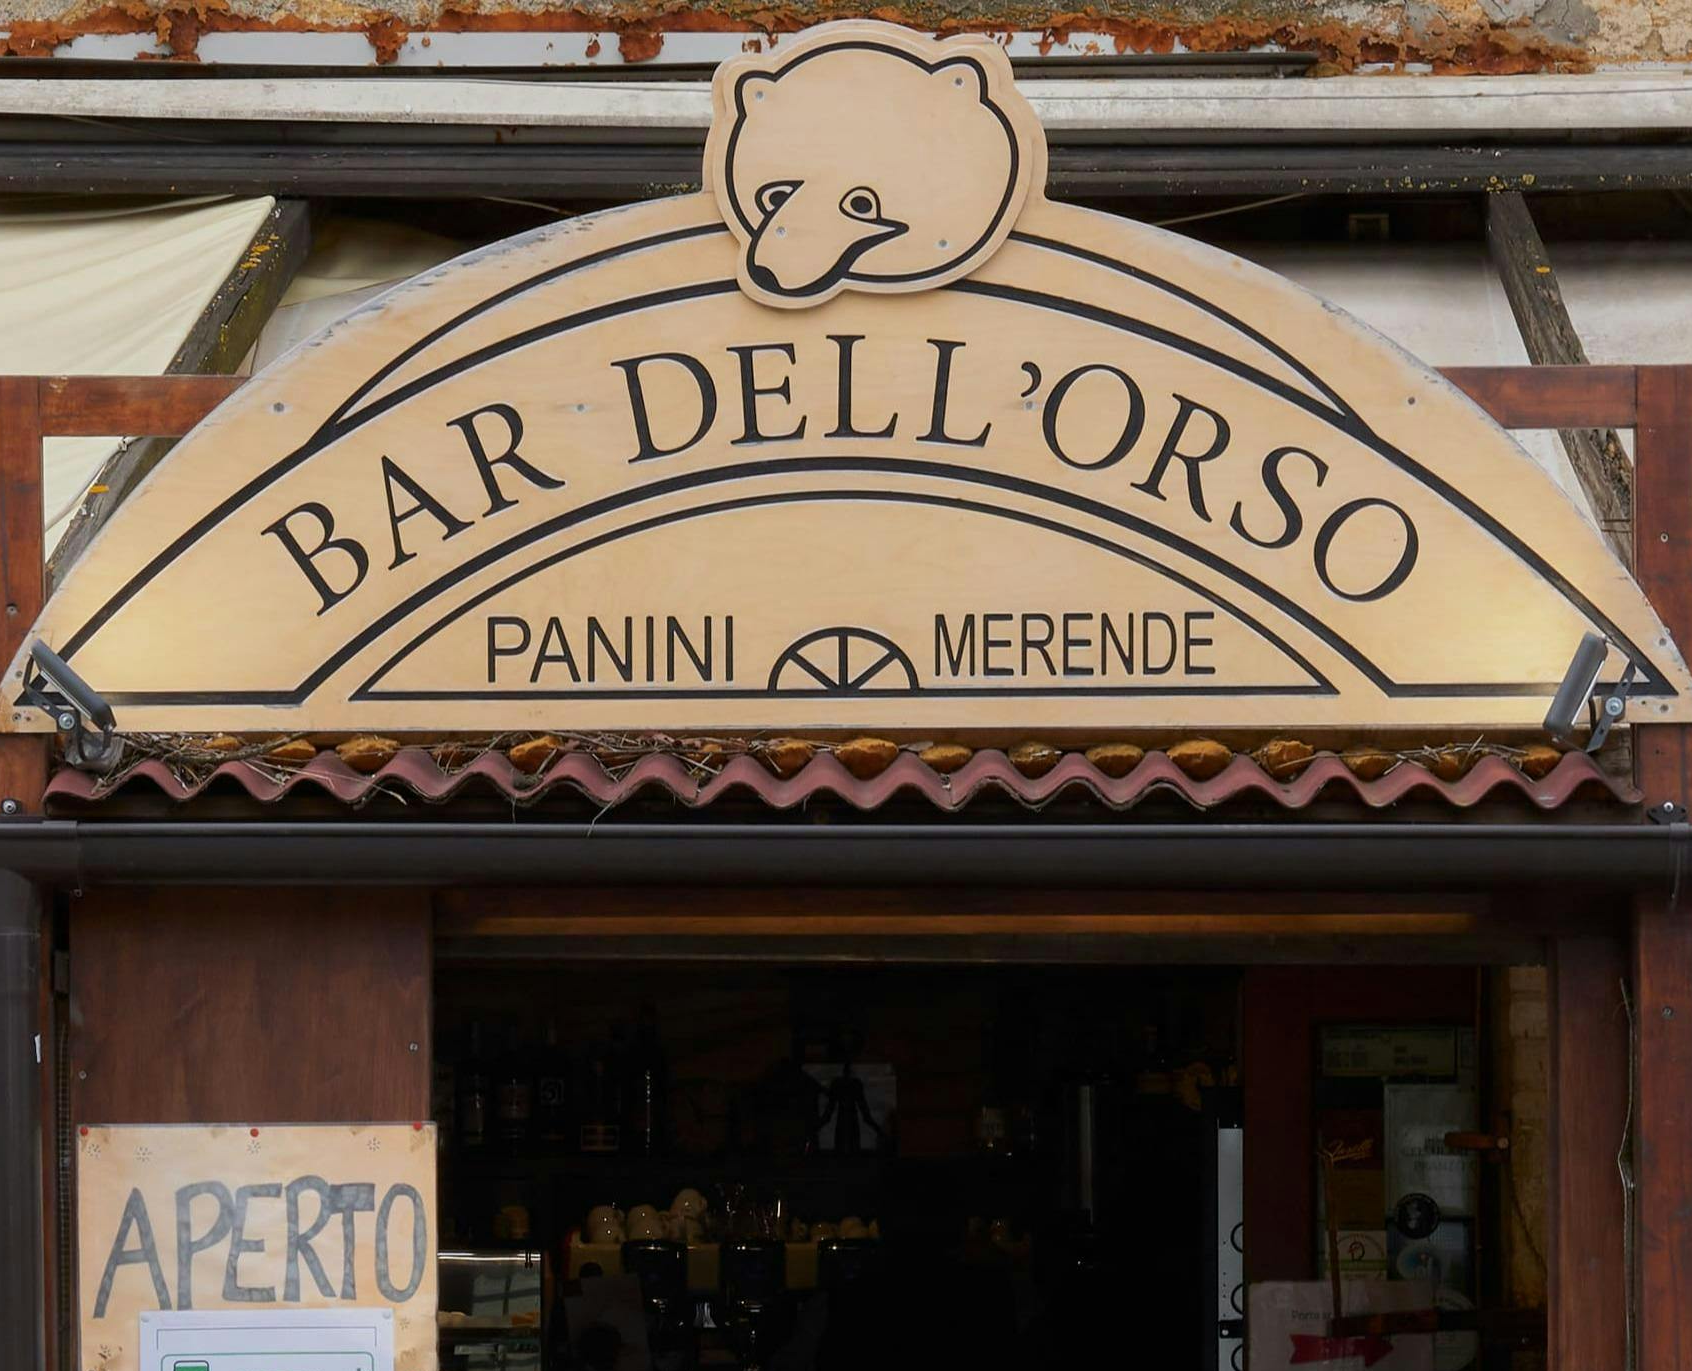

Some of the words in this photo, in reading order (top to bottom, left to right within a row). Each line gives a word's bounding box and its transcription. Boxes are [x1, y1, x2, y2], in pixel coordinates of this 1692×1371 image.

[259, 402, 567, 618] BAR
[610, 333, 1422, 606] DELL'ORSO
[485, 614, 737, 685] PANINI
[933, 609, 1215, 678] MERENDE
[93, 1175, 427, 1318] APERTO
